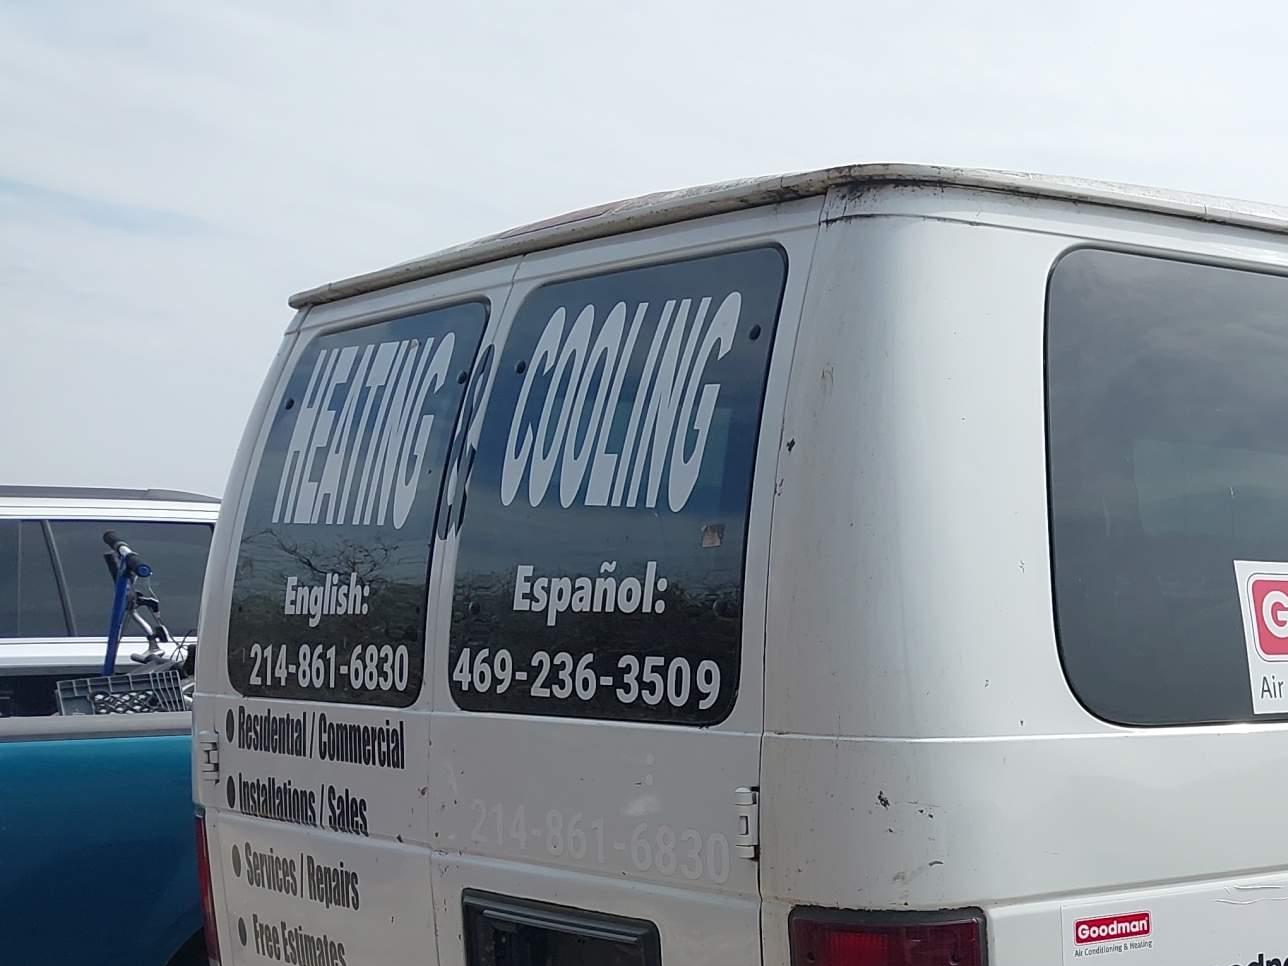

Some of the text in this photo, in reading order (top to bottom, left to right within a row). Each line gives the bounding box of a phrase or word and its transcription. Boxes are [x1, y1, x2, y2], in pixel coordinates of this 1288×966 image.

[271, 332, 456, 529] HEATING
[500, 291, 742, 513] COOLING
[284, 572, 370, 627] English:
[512, 561, 668, 626] Español:
[249, 644, 409, 692] 214-861-6830
[453, 647, 720, 711] 469-236-3509
[1261, 676, 1284, 699] Air
[238, 705, 405, 769] Residential / Commercial
[238, 772, 369, 837] Installations / Sales
[471, 799, 731, 884] 214-861-6830
[245, 842, 297, 896] Services
[307, 855, 359, 911] Repairs
[253, 914, 281, 960] Free
